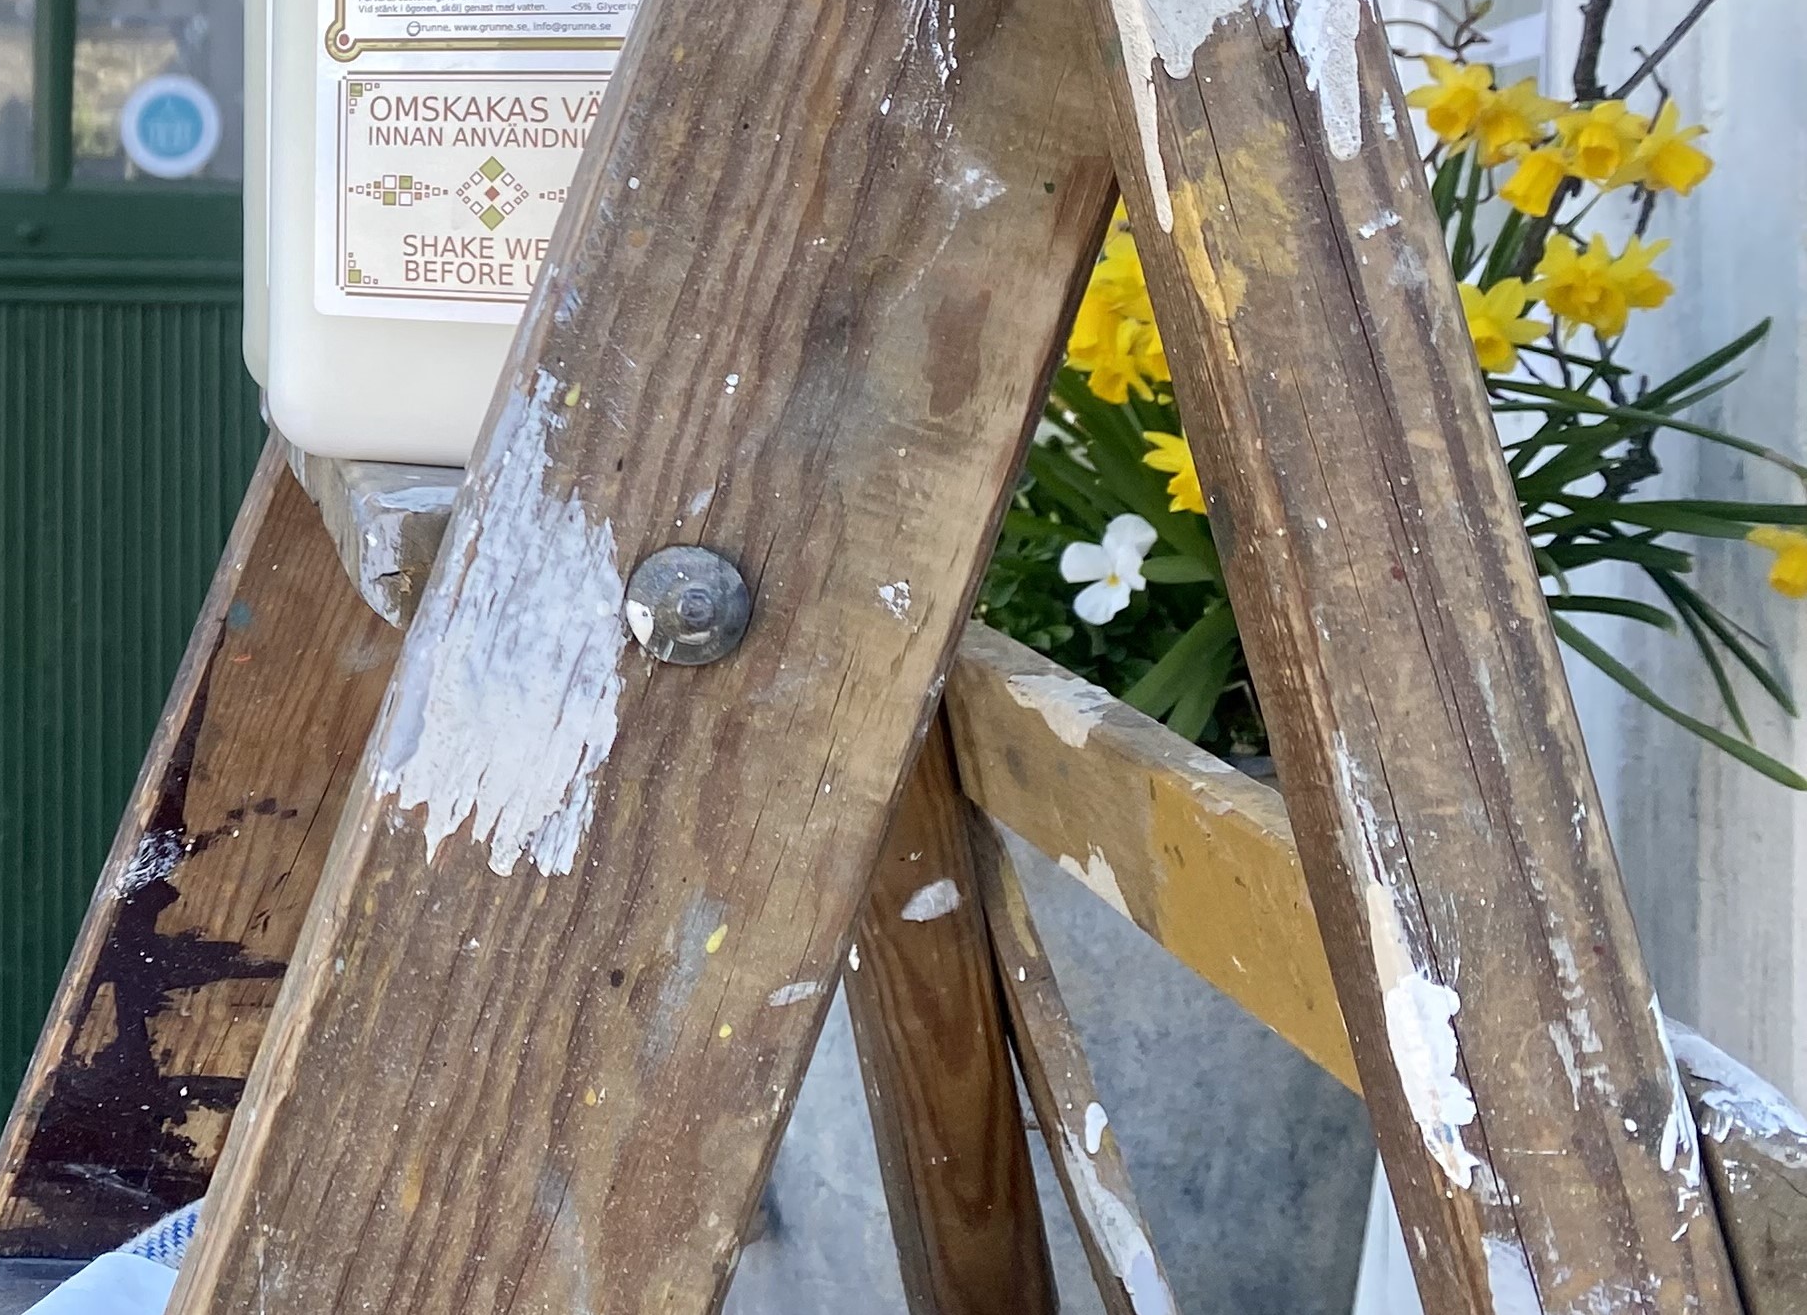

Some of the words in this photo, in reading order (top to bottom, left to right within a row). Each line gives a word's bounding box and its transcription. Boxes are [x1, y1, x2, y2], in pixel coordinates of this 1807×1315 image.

[358, 4, 372, 13] Vid
[496, 3, 514, 11] med
[370, 95, 549, 123] OMSKAKAS
[368, 126, 443, 147] INNAN
[403, 234, 494, 260] SHAKE
[405, 259, 514, 286] BEFORE
